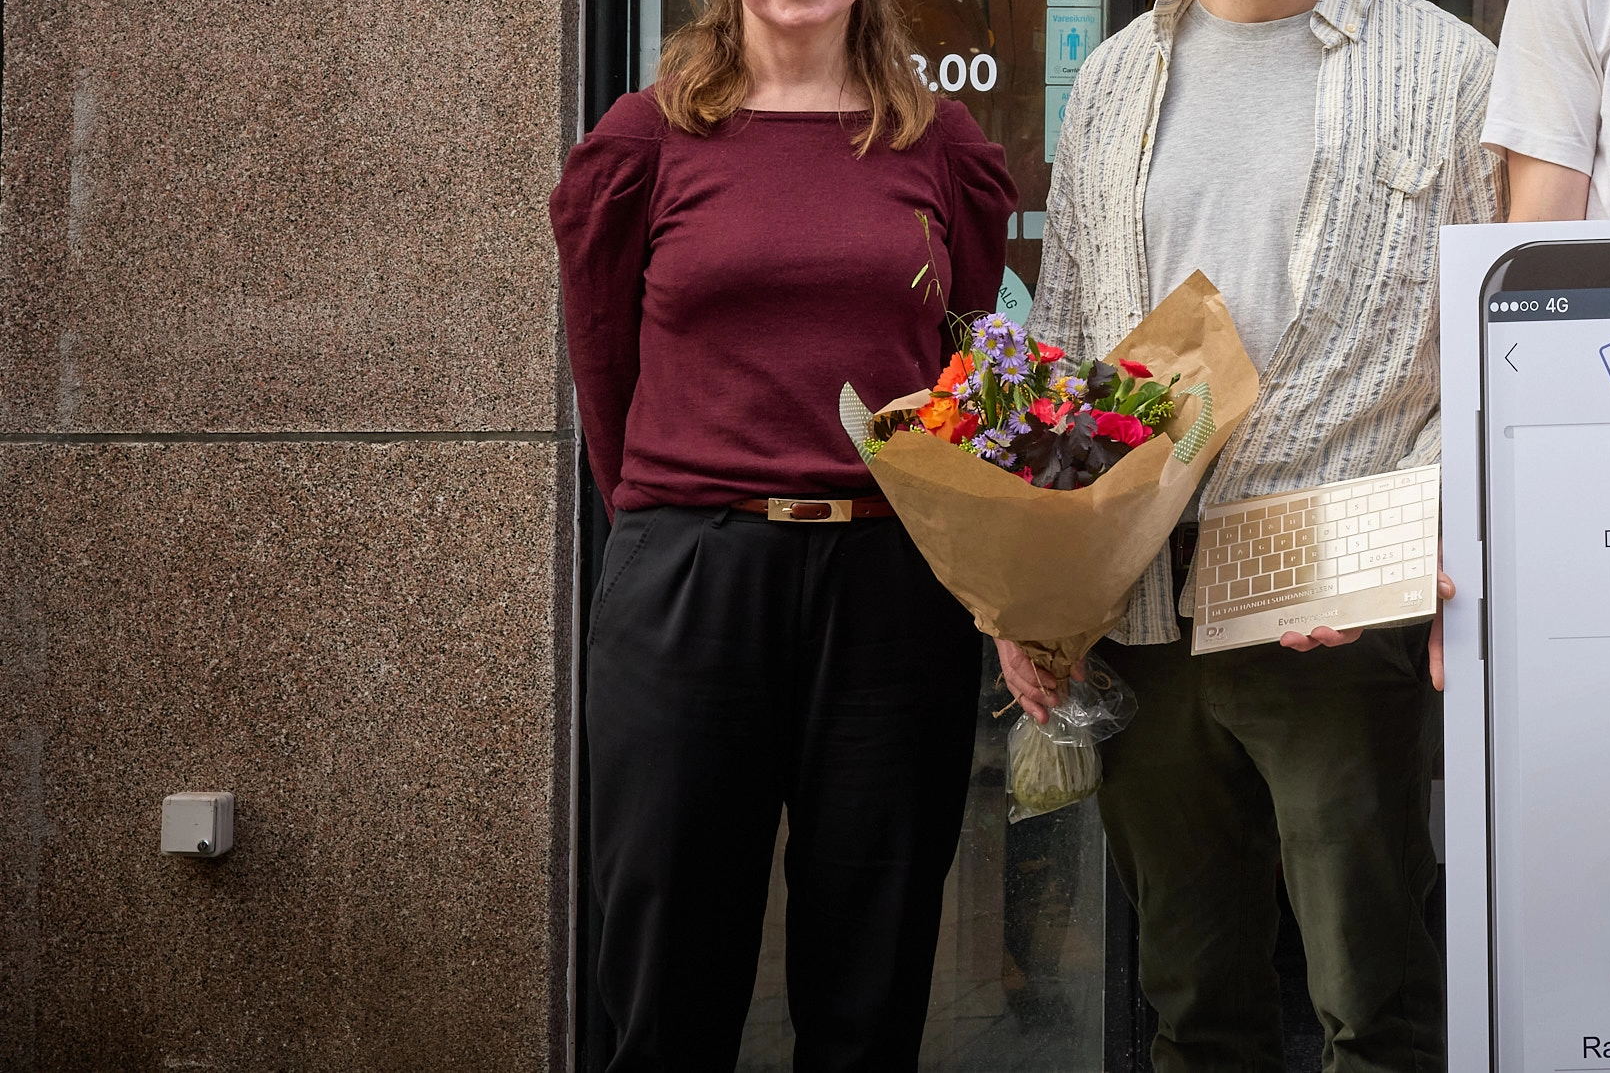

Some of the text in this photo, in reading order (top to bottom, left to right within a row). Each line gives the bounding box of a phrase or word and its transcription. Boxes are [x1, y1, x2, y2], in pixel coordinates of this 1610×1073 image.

[1052, 15, 1095, 24] Varesikring
[1545, 296, 1569, 314] 4G
[1369, 551, 1394, 563] 2025
